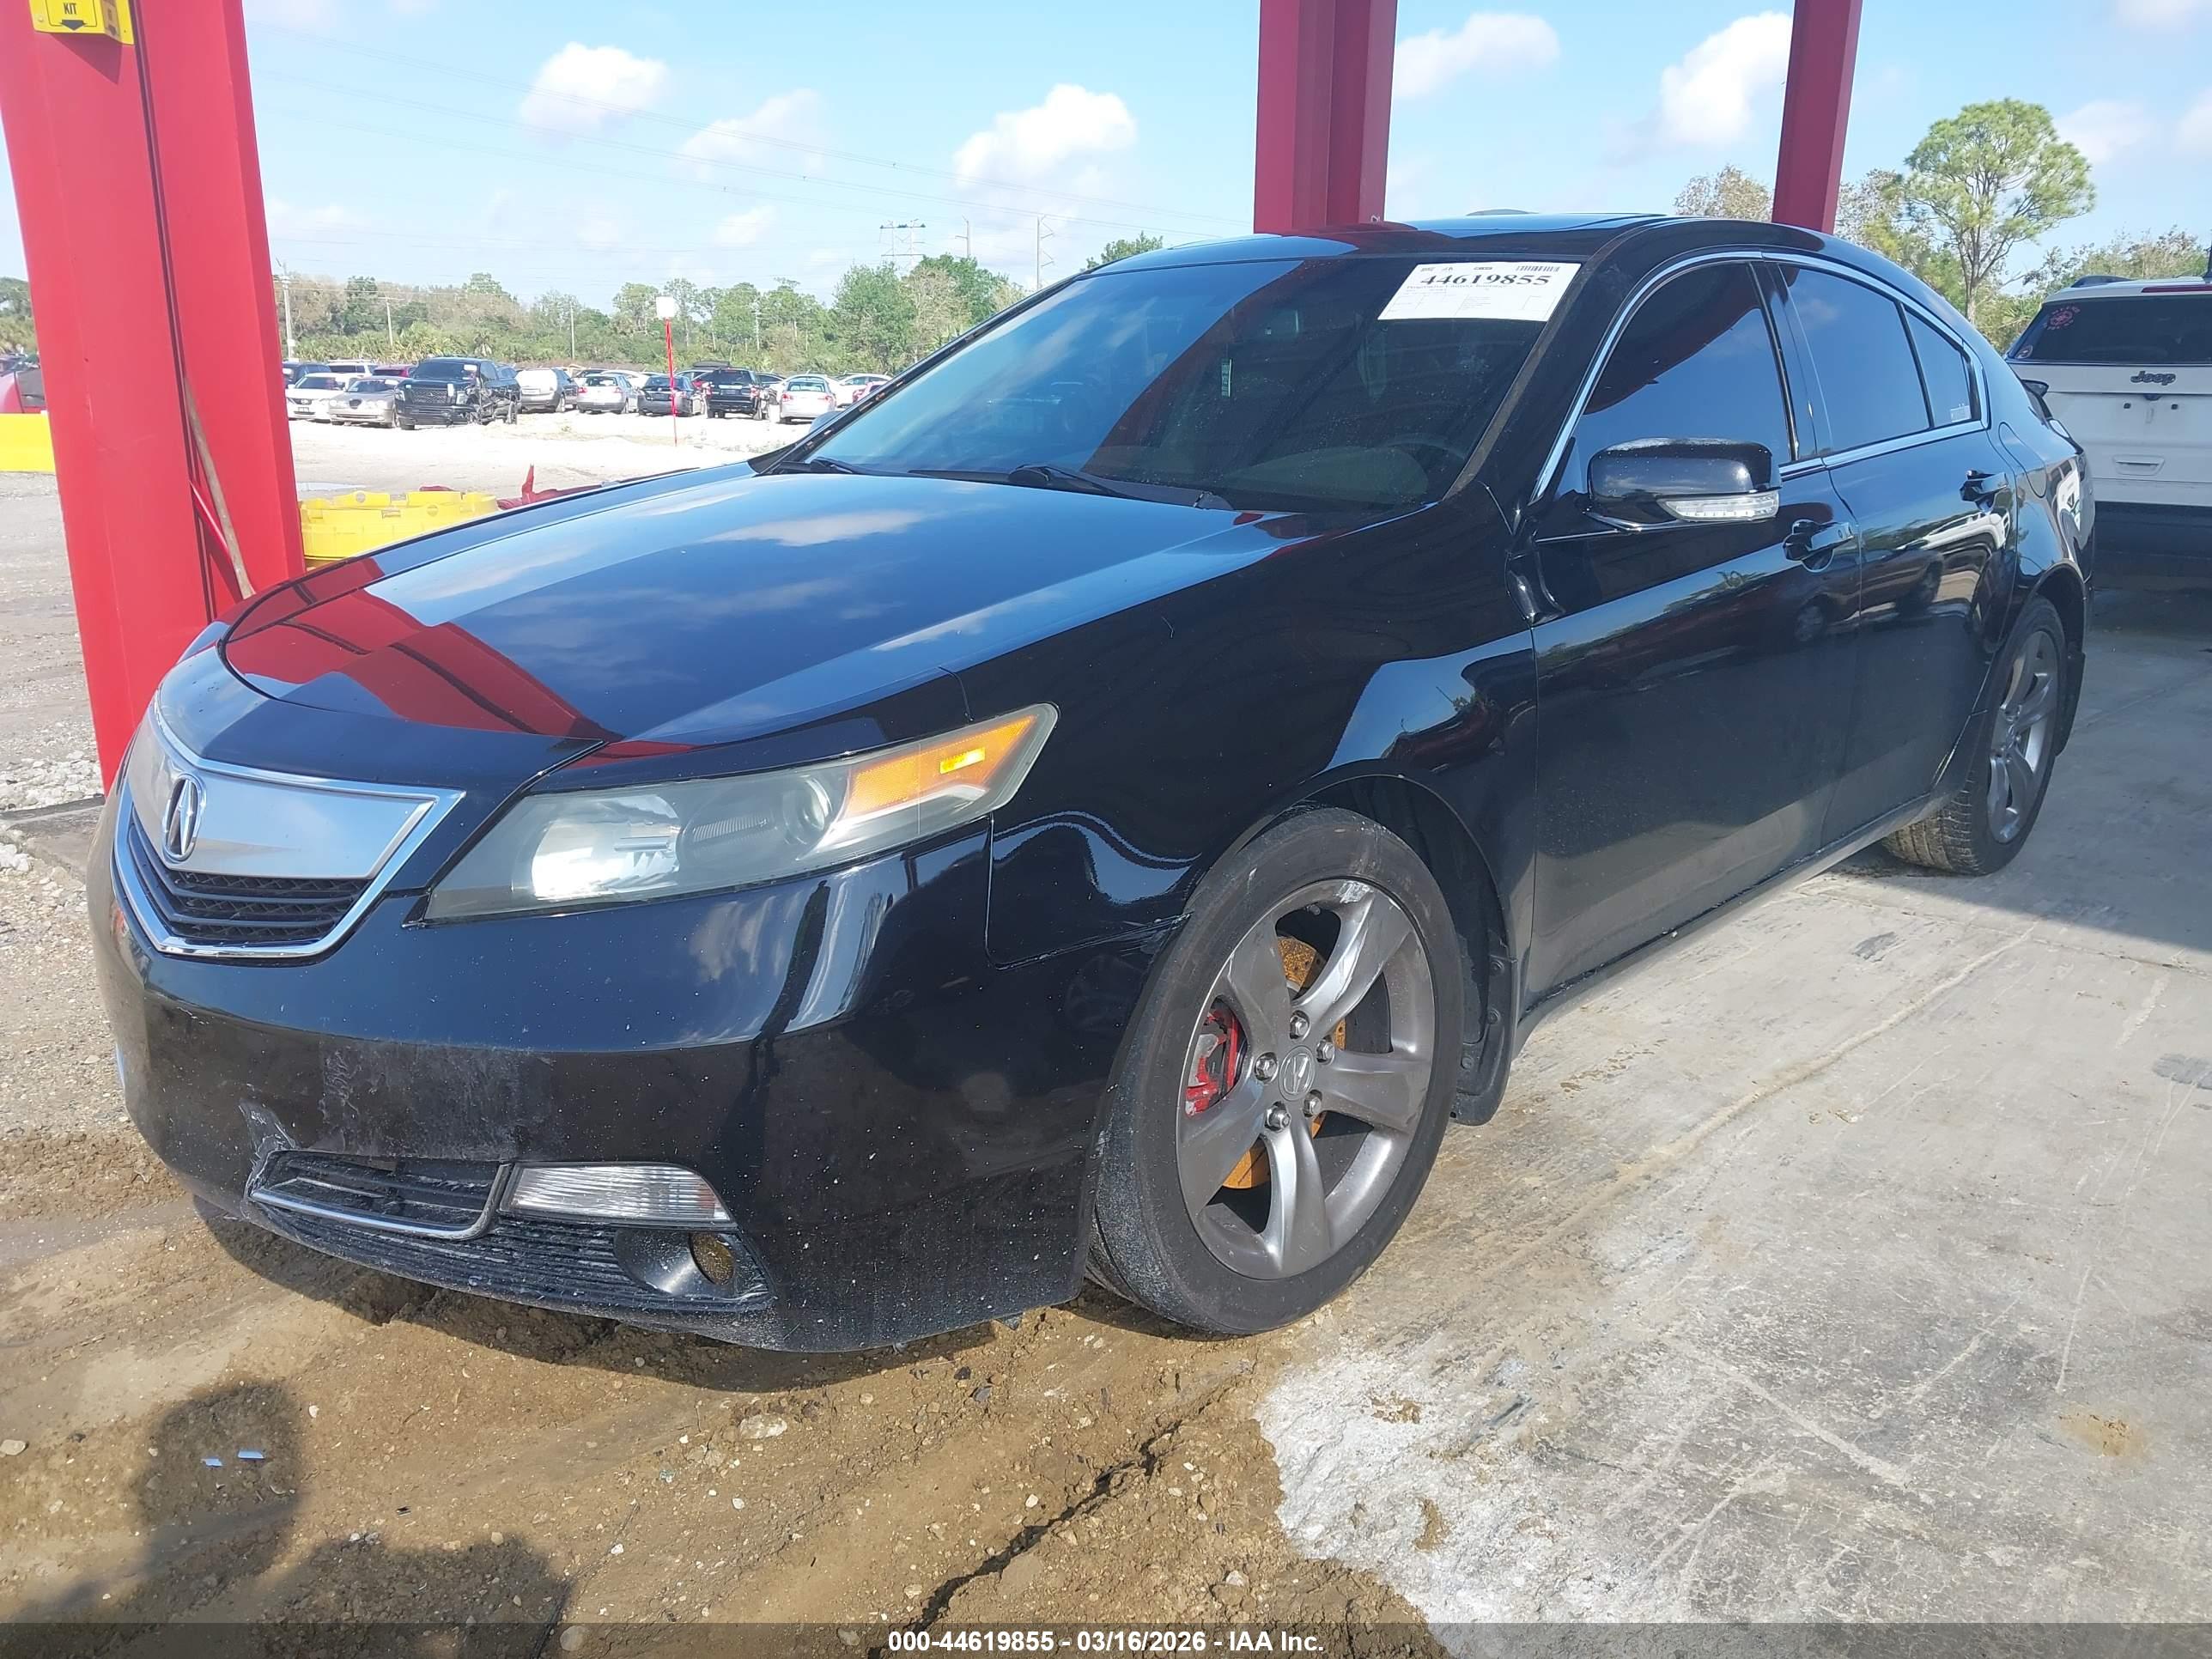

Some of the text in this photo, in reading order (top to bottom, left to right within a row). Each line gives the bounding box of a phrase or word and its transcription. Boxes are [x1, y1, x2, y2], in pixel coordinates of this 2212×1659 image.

[64, 3, 77, 15] KIT
[1421, 274, 1551, 285] 44619855
[2130, 371, 2176, 386] Jeep
